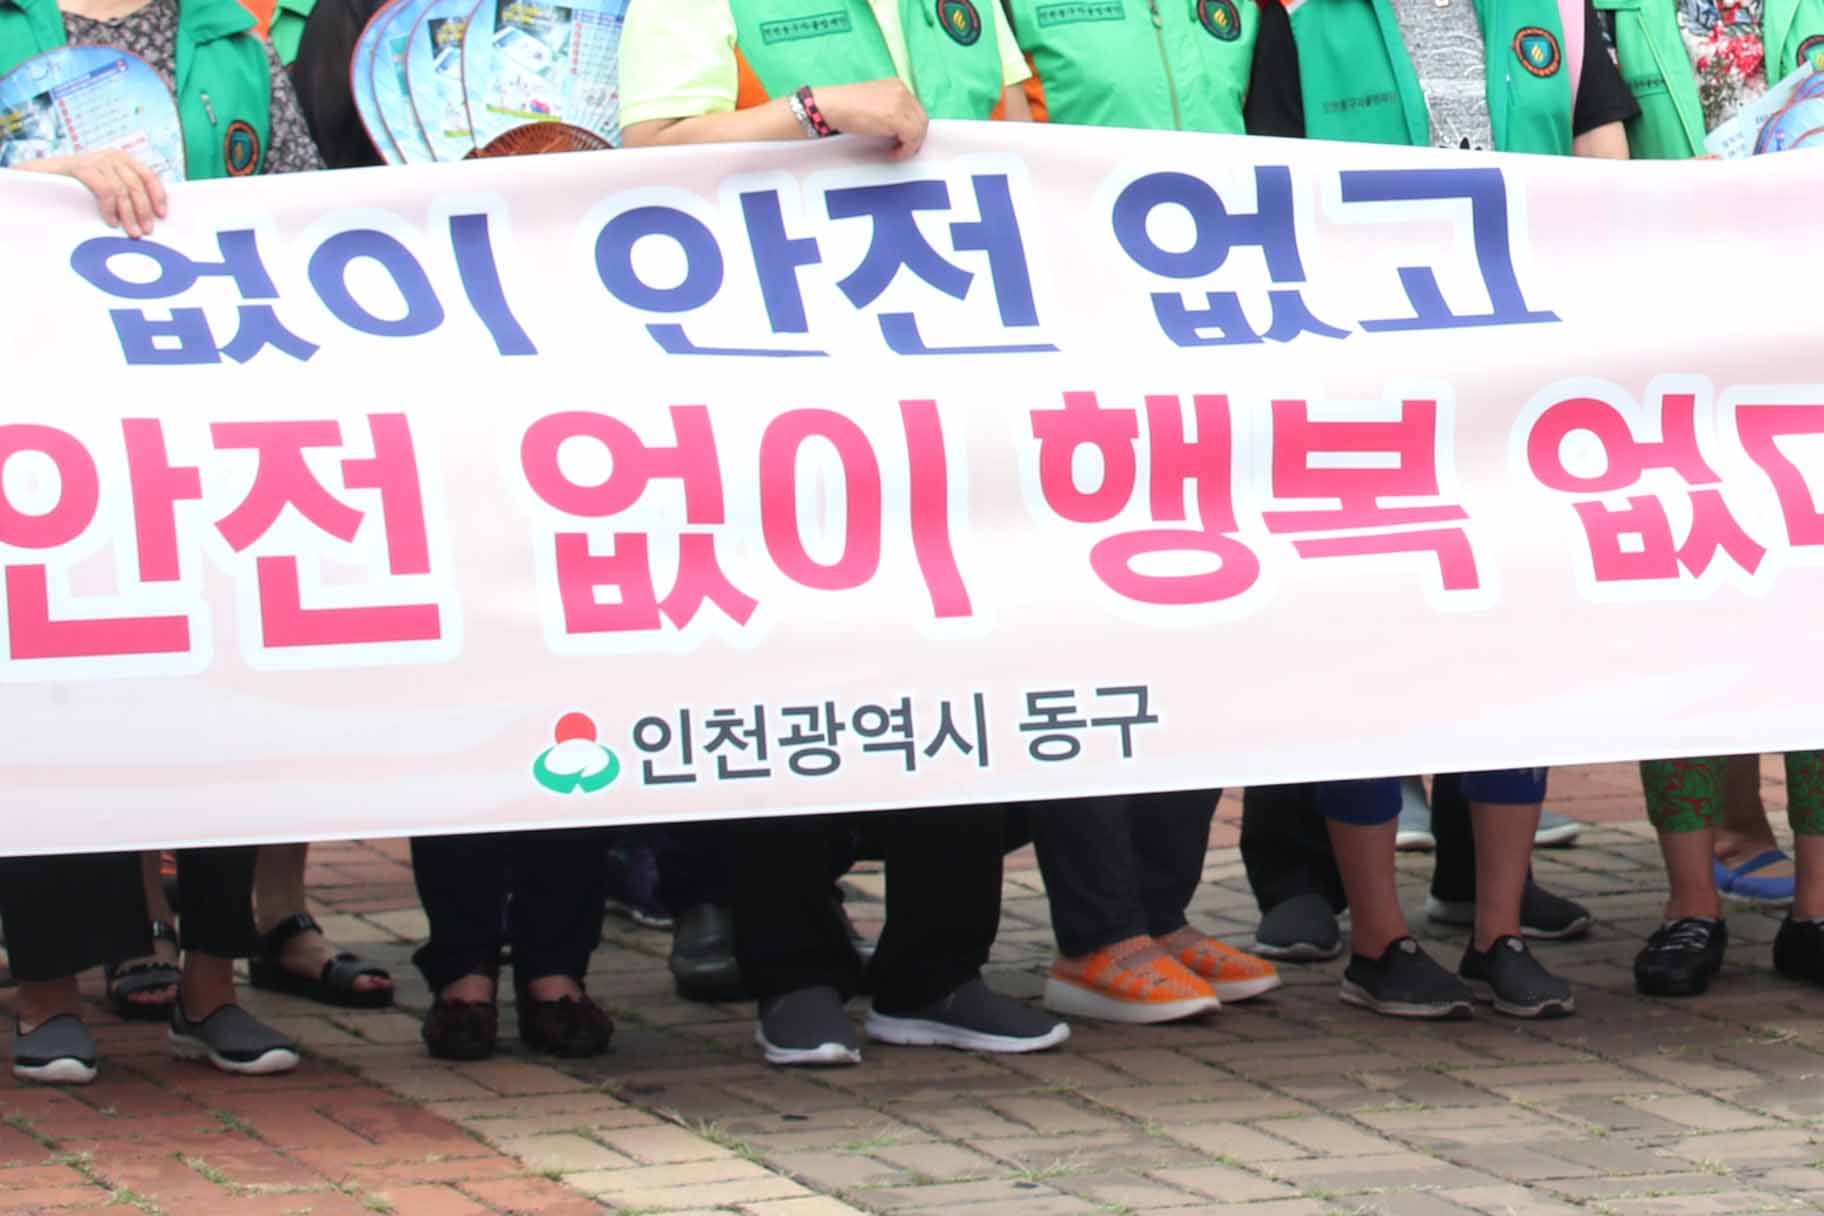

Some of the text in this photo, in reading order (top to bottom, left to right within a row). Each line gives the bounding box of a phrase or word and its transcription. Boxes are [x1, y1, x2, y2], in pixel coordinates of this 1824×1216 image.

[71, 165, 1563, 366] 없이 안전 없고
[0, 412, 442, 660] 안전
[521, 398, 974, 634] 없이
[1029, 391, 1481, 606] 행복
[632, 684, 1160, 785] 인천광역시 동구
